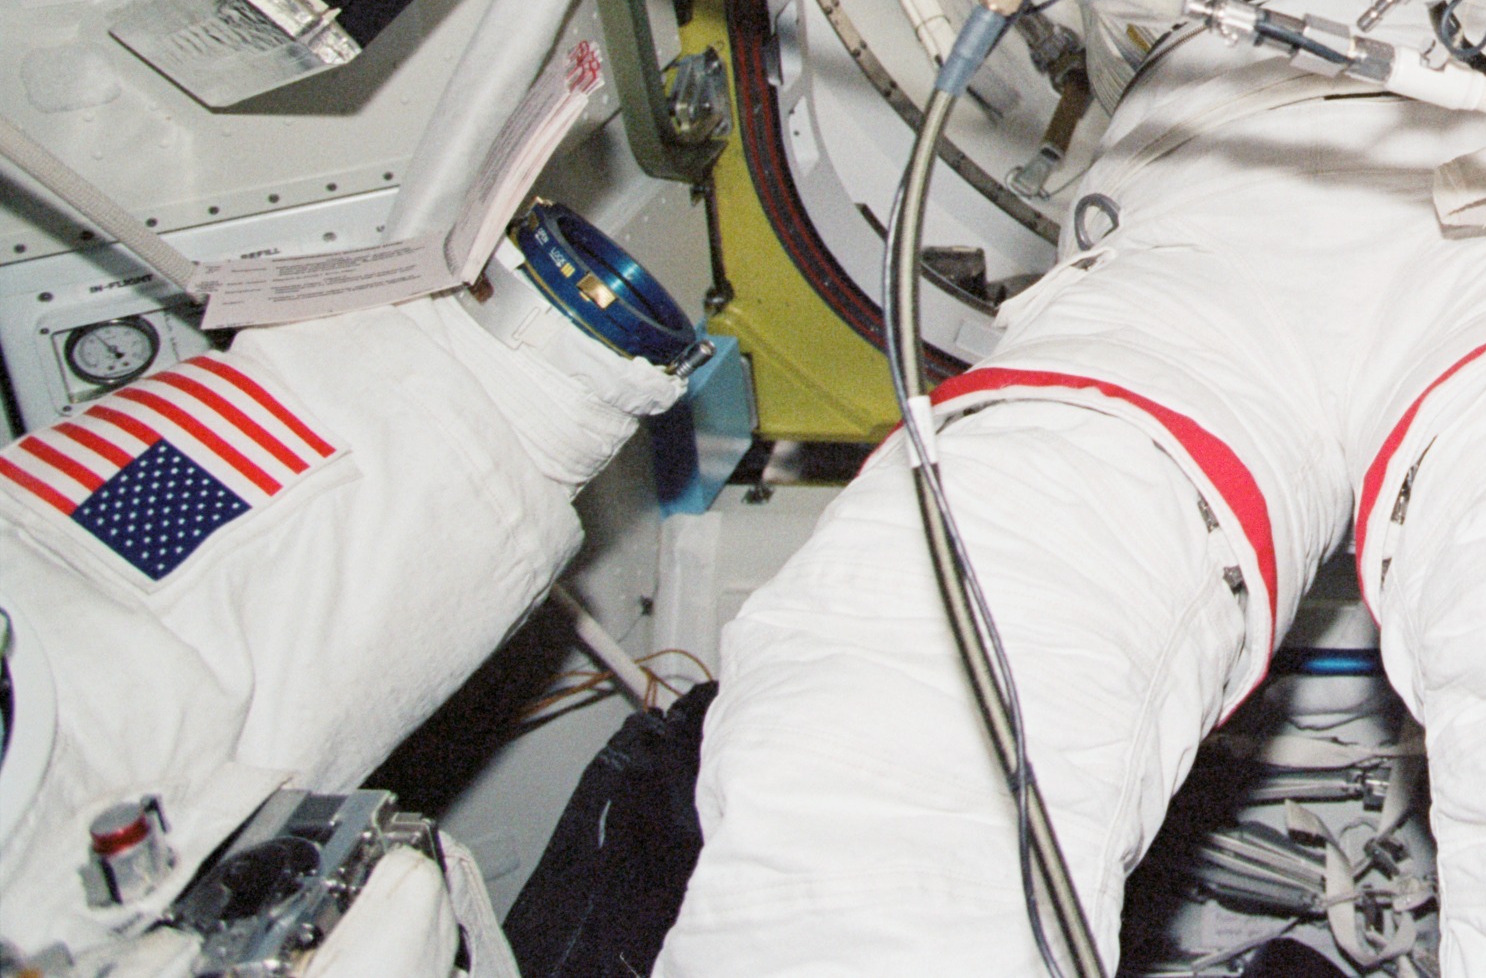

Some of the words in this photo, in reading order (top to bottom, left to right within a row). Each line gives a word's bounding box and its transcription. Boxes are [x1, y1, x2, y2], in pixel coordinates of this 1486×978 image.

[240, 248, 281, 260] REFILL
[550, 247, 567, 265] LOCK
[89, 274, 154, 293] IN-FLIGHT
